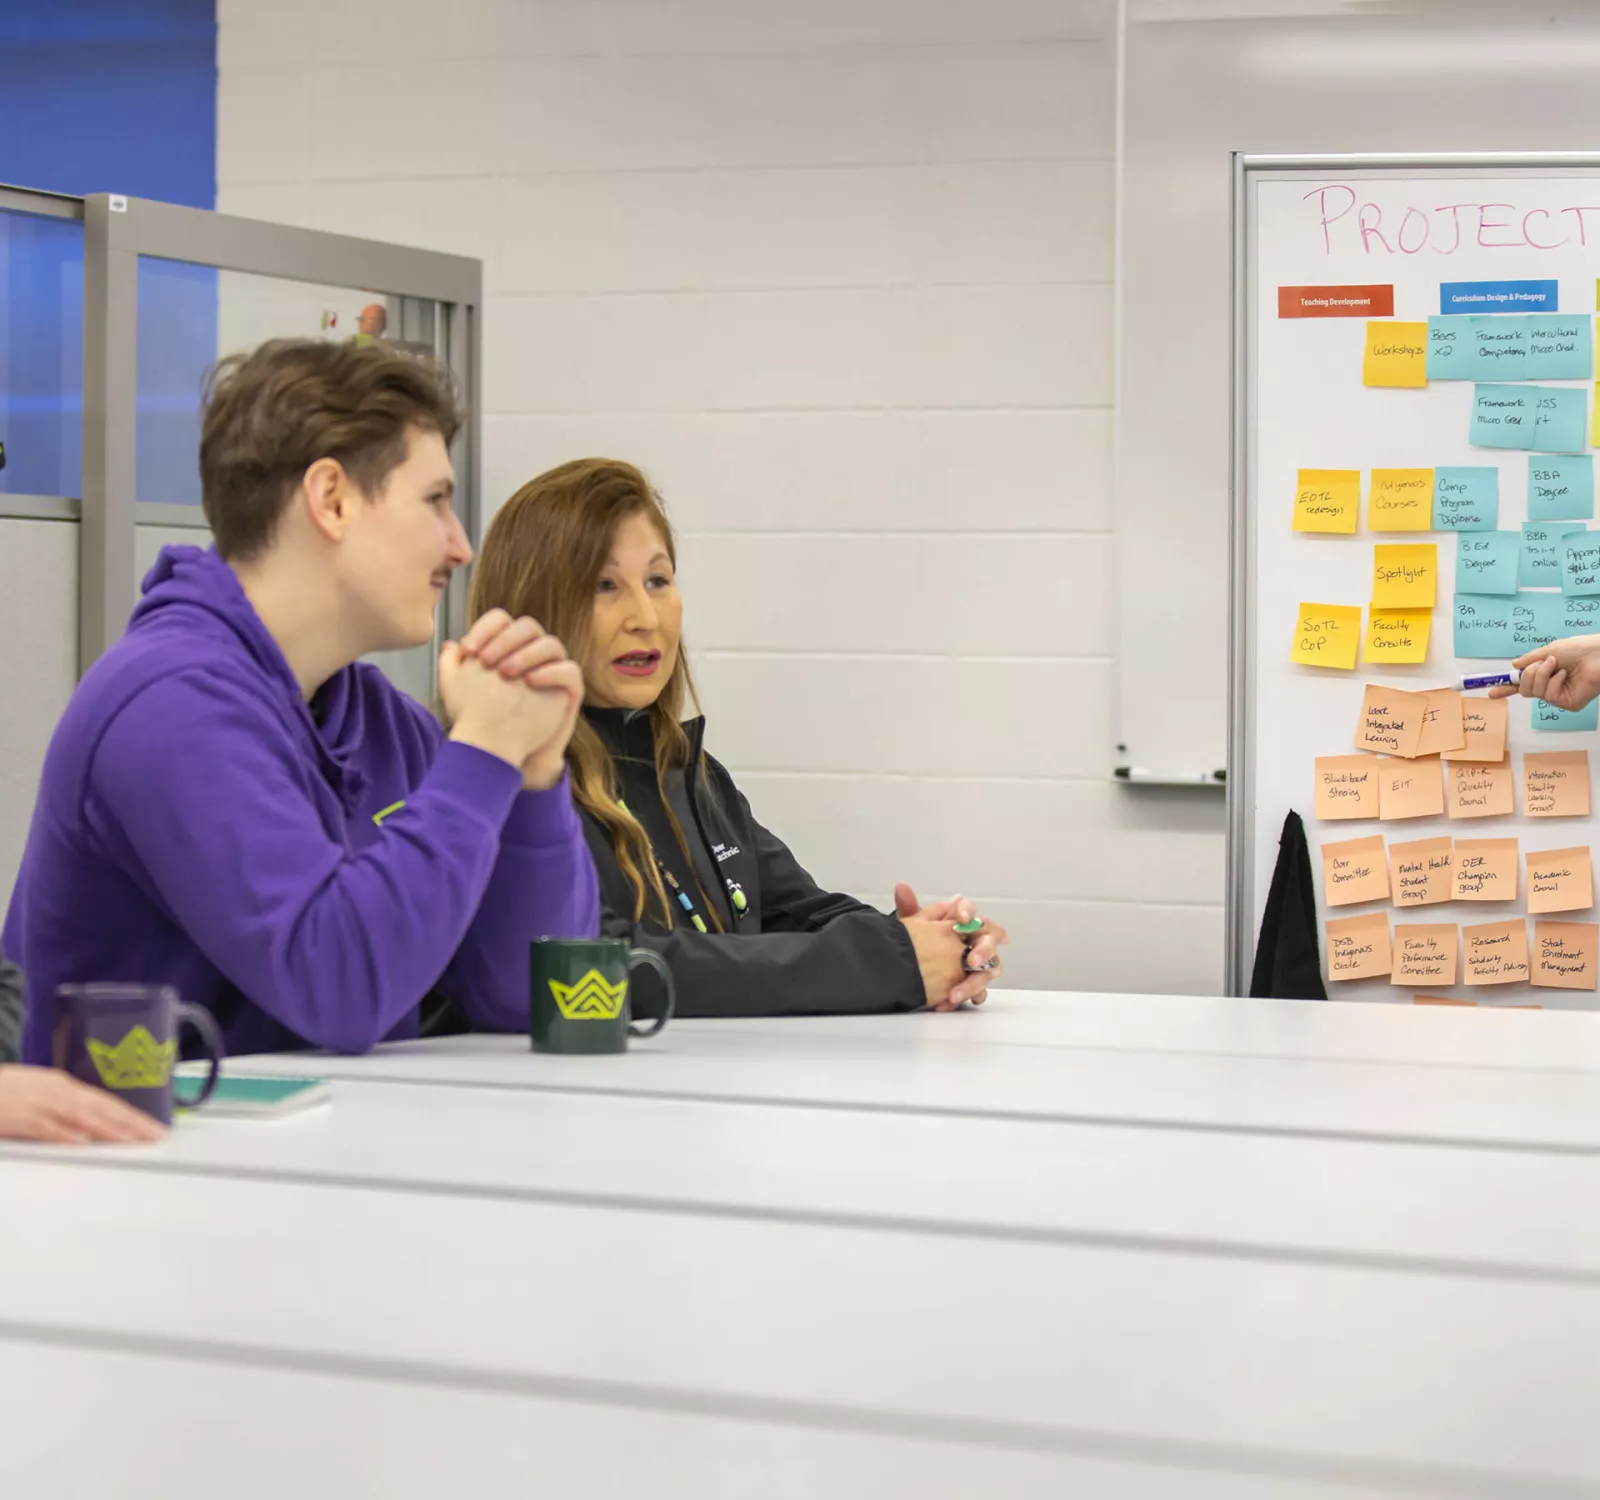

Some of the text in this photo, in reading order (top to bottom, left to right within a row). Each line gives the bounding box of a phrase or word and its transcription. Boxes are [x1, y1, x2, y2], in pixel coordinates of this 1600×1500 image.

[1301, 297, 1371, 307] Teaching Development
[1452, 294, 1486, 302] Curriculum
[1487, 294, 1508, 303] Design
[1515, 293, 1546, 301] Pedagogy
[1477, 415, 1501, 425] Micro
[1533, 470, 1561, 480] BBA
[1438, 479, 1467, 494] Comp
[1535, 486, 1570, 501] Degree
[1375, 496, 1418, 510] Courses
[1440, 496, 1475, 512] Program
[1462, 558, 1496, 573] Degree
[1376, 565, 1427, 583] Spotlight
[1373, 619, 1411, 632] Faculty
[1513, 622, 1537, 632] Tech
[1365, 719, 1404, 734] Integrated
[1365, 733, 1399, 750] Learning
[1400, 874, 1429, 887] Student
